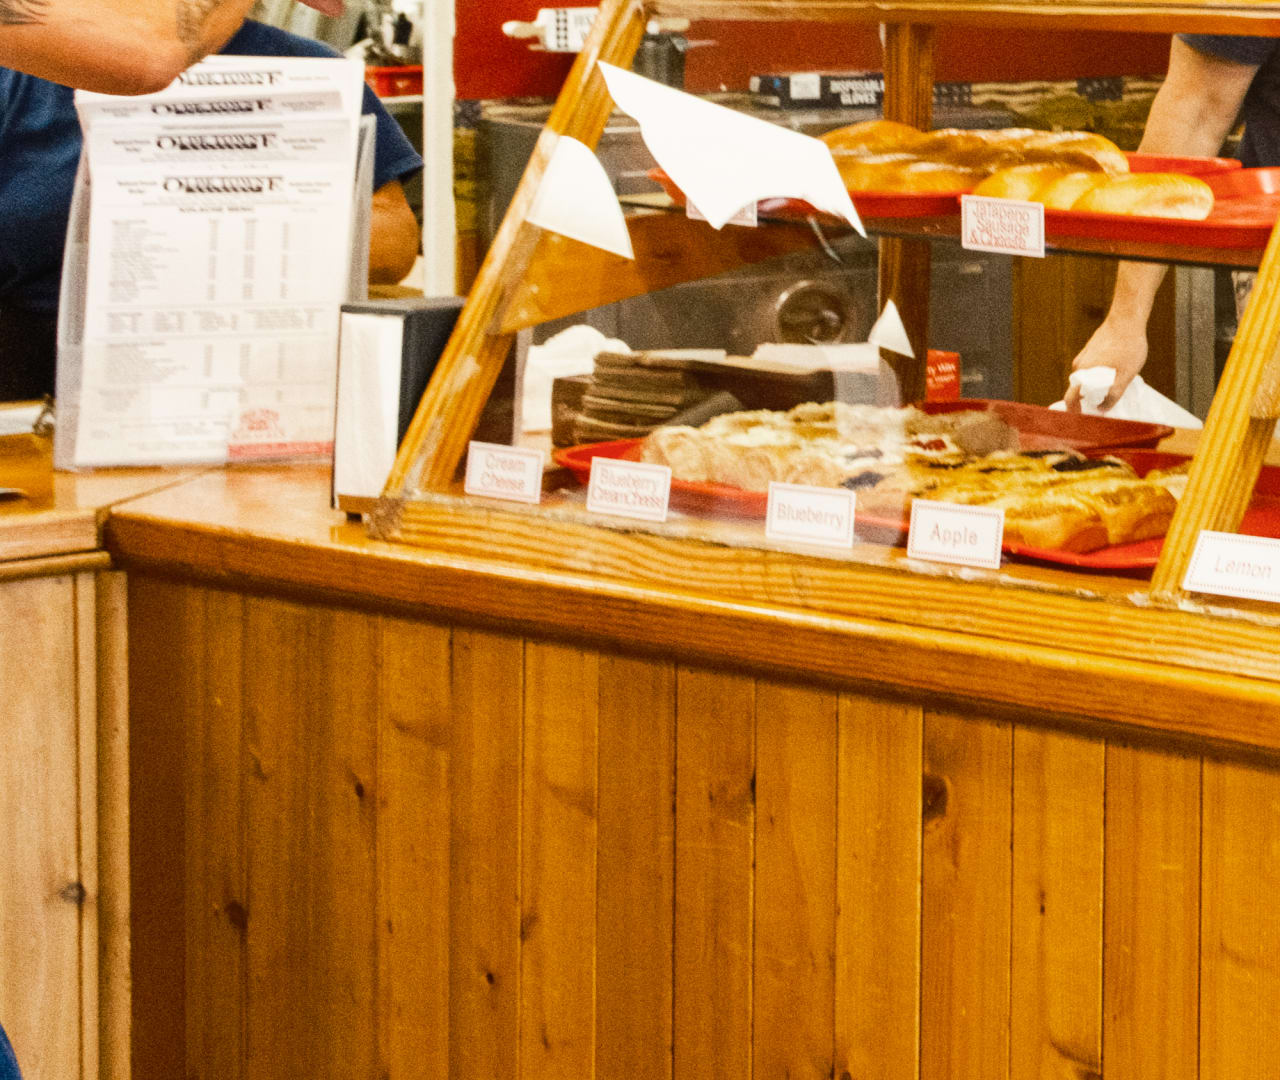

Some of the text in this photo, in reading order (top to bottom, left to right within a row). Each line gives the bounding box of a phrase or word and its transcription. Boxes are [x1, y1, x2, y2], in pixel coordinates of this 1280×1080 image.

[776, 502, 845, 531] Blueberry
[929, 522, 979, 549] Apple
[1213, 553, 1273, 580] Lemon
